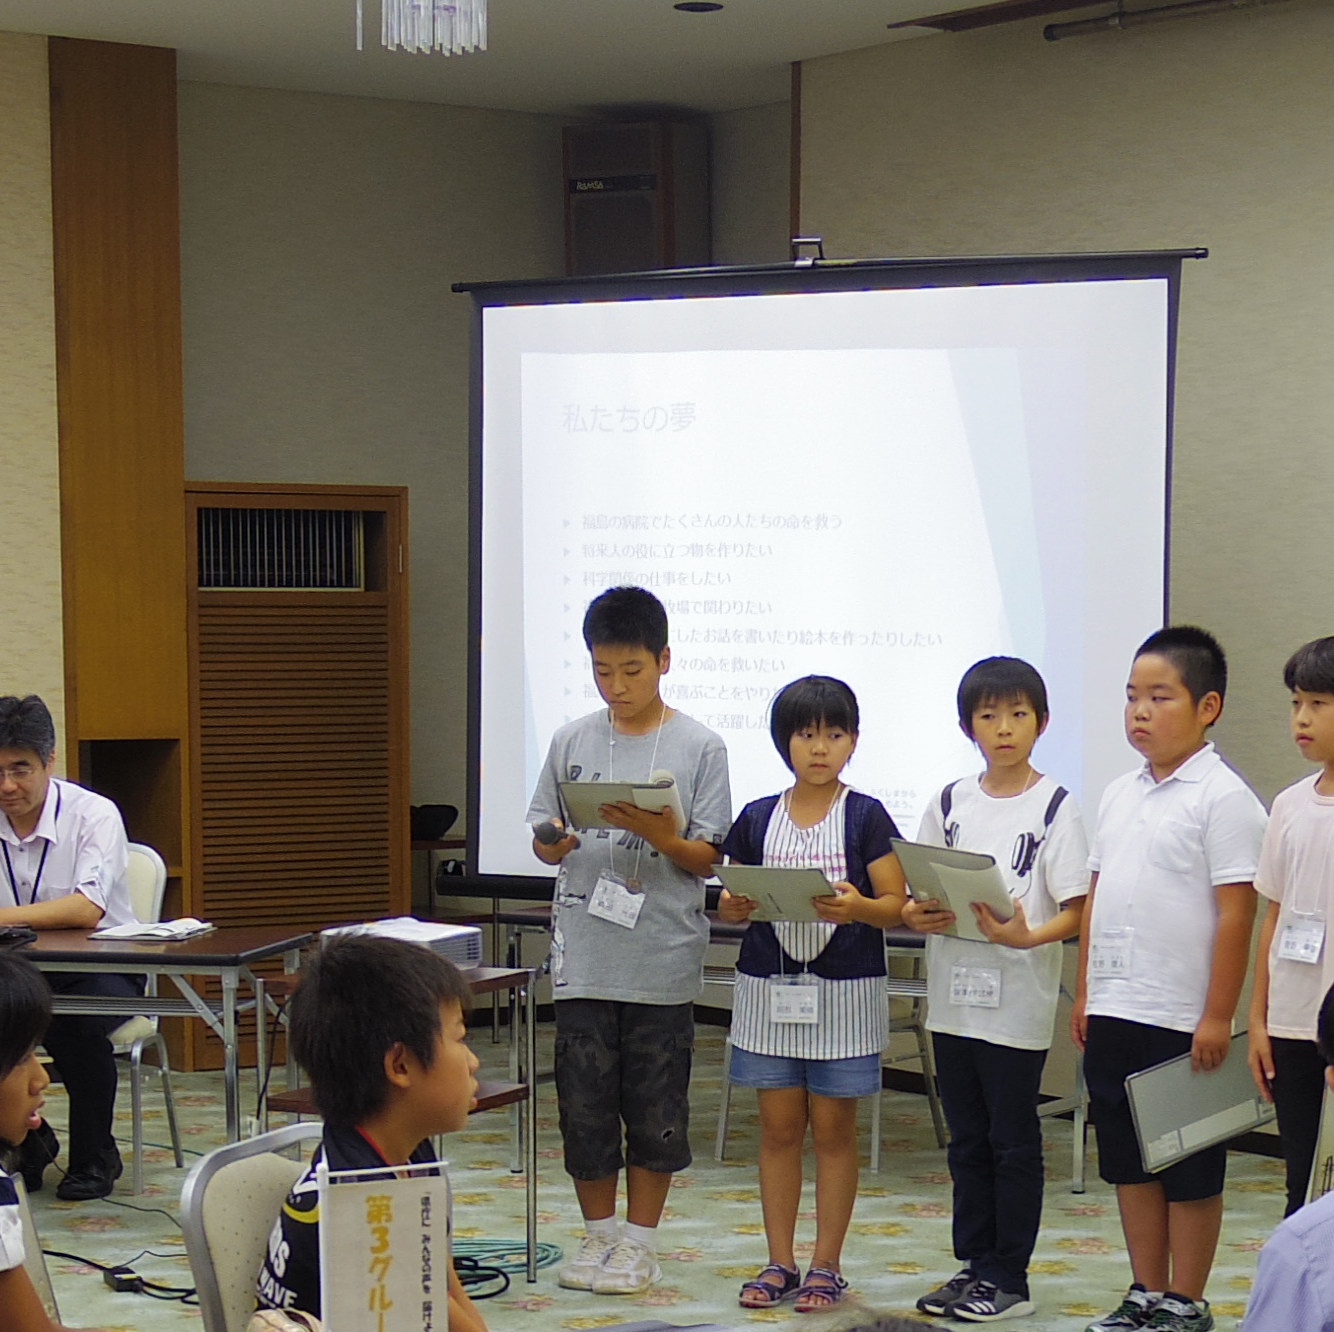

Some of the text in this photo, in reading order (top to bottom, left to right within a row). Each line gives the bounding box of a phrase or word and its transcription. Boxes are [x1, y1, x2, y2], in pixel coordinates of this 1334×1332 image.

[576, 181, 604, 190] RAMSA
[562, 401, 697, 433] 私たちの夢
